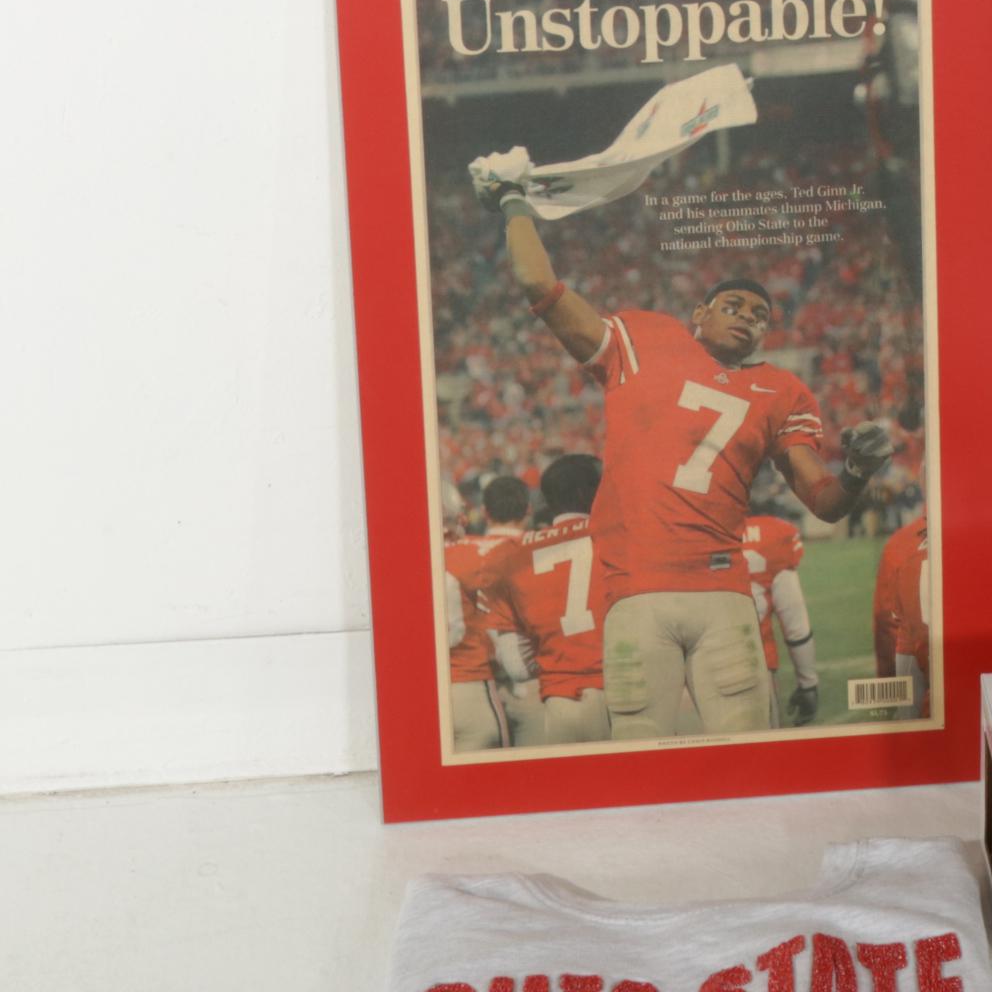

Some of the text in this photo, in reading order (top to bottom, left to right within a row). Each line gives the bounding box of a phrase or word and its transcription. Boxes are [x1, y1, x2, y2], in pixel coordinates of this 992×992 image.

[644, 194, 658, 206] In
[672, 195, 707, 208] game
[710, 191, 728, 203] for
[732, 190, 752, 202] the
[791, 187, 814, 199] Ted
[817, 185, 846, 197] Ginn
[659, 208, 683, 220] and
[687, 207, 706, 219] his
[708, 205, 778, 218] teammates
[781, 202, 822, 215] thump
[673, 216, 829, 236] sending Ohio State to the
[660, 231, 844, 251] national championship game.
[673, 380, 750, 494] 7
[532, 536, 595, 637] 7
